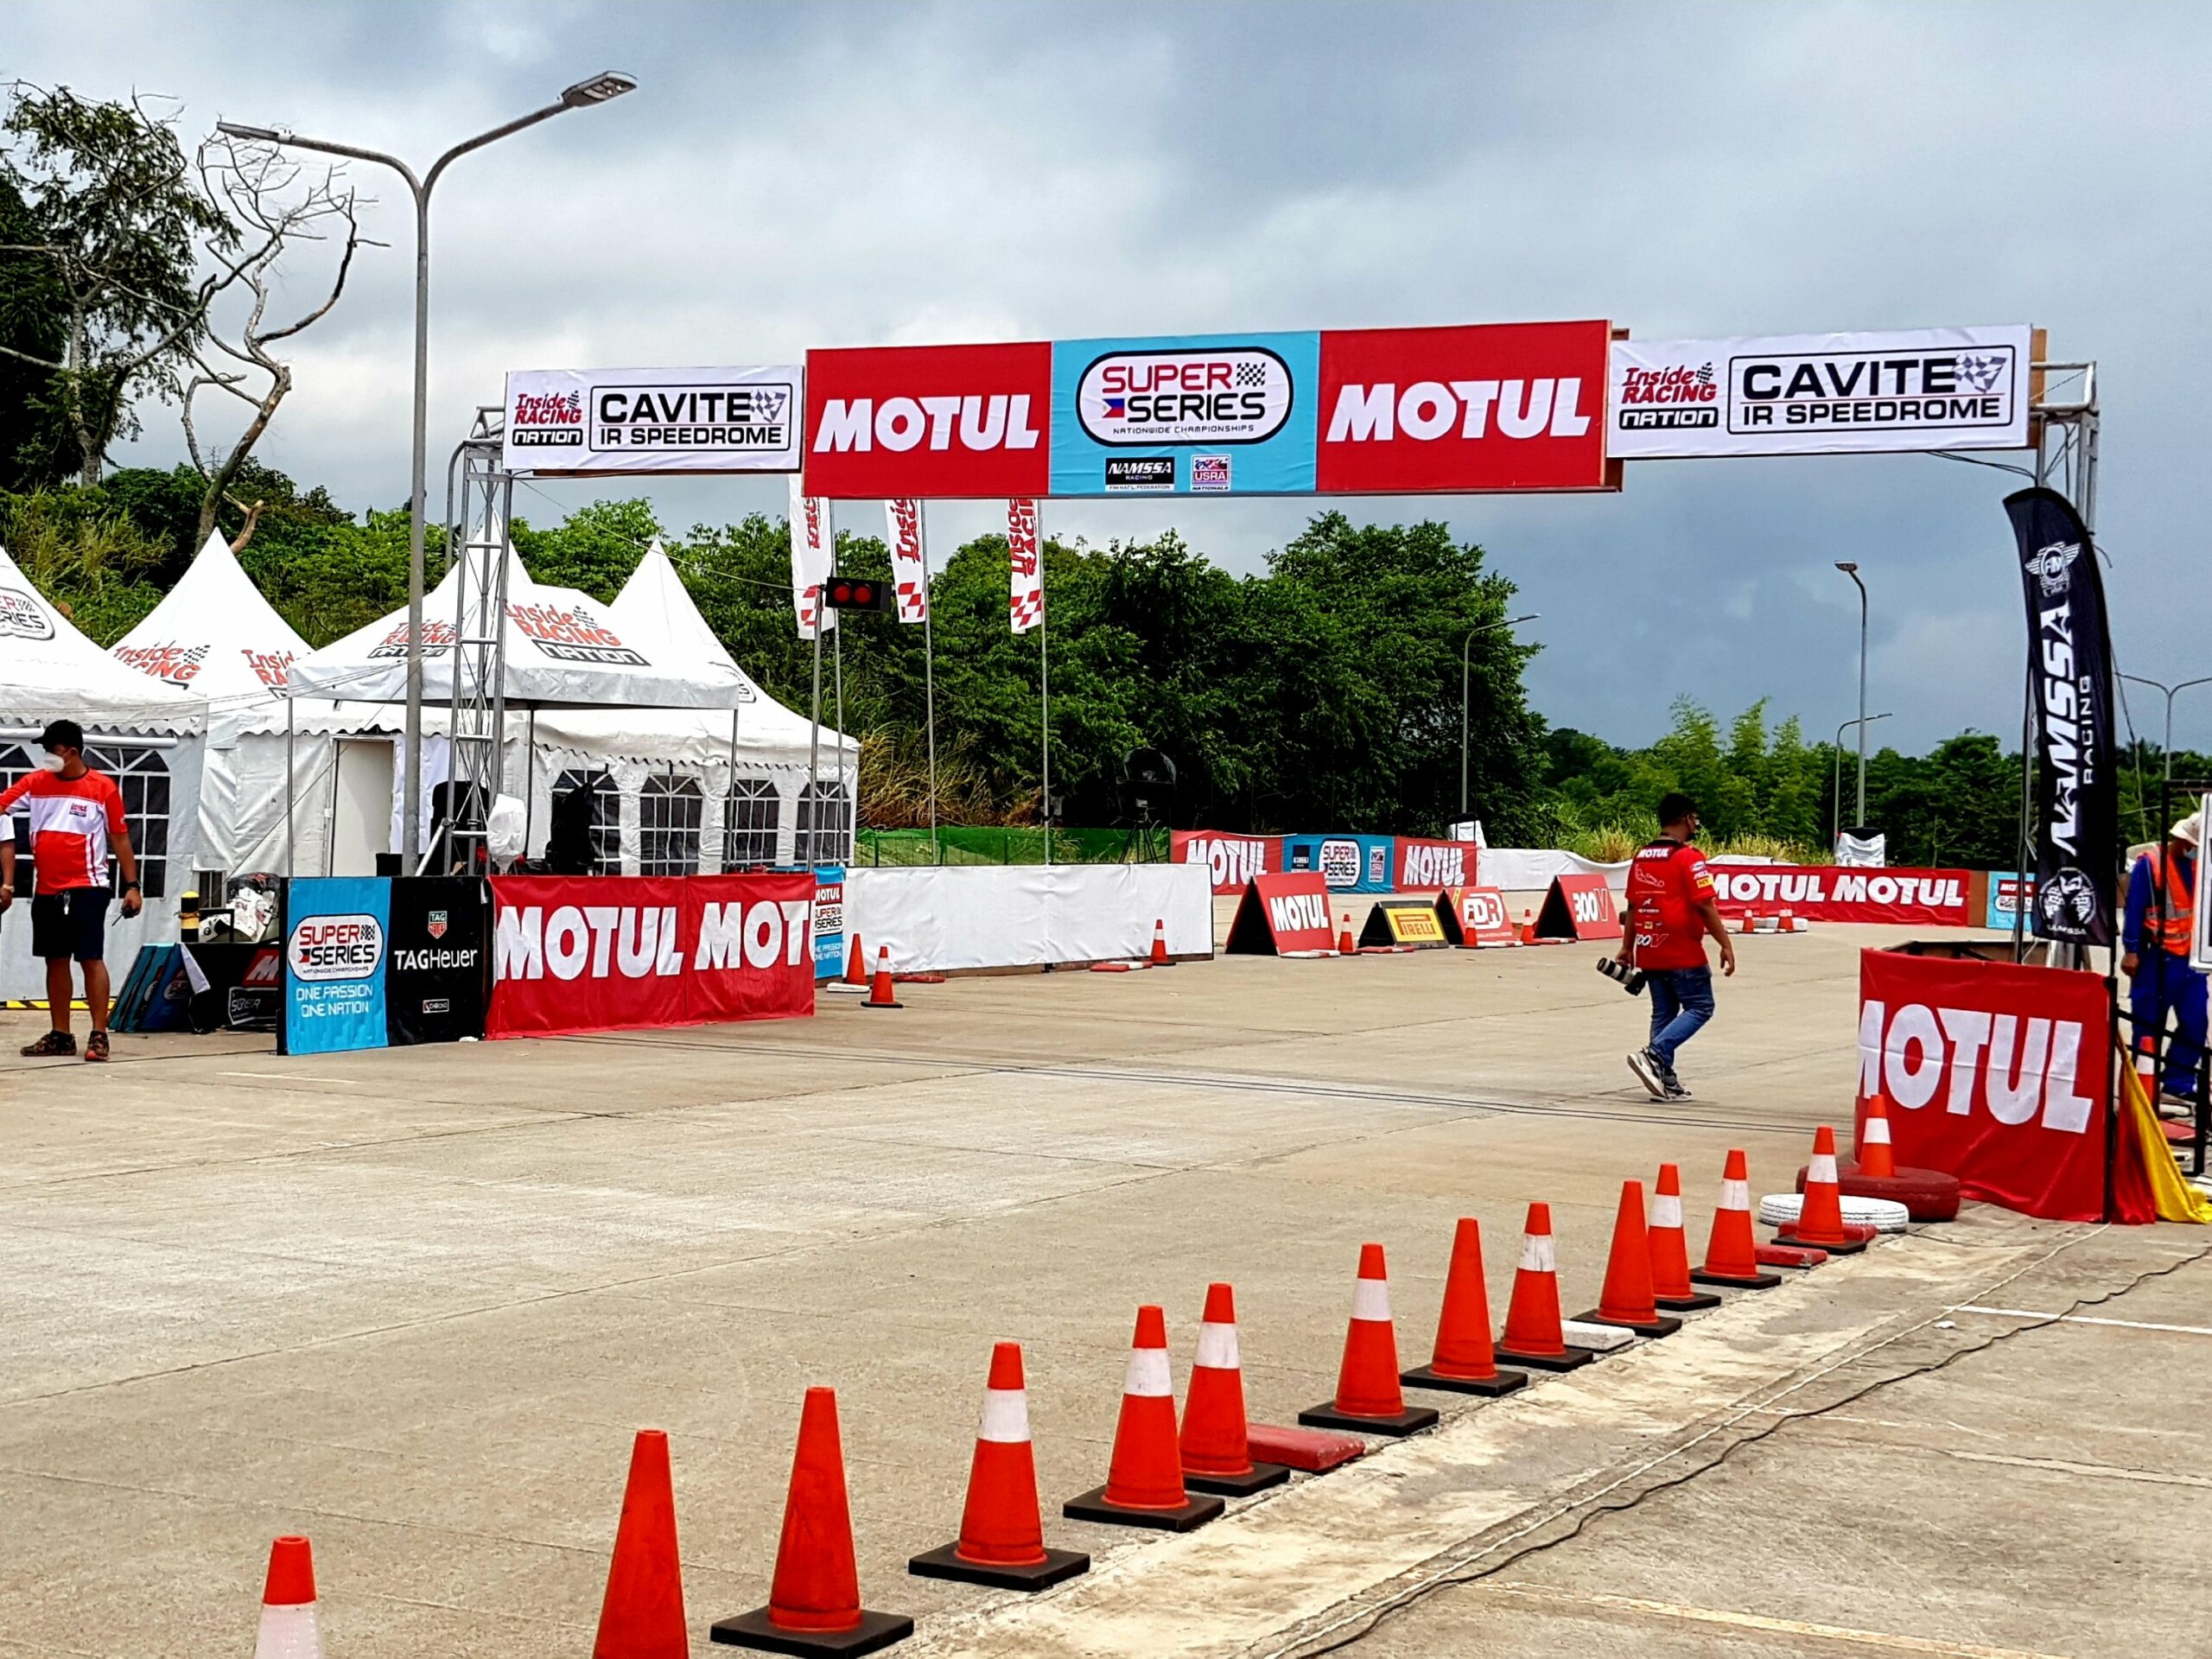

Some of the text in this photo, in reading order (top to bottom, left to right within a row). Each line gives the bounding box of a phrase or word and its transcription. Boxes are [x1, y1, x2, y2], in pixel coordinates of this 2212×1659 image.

[1102, 362, 1233, 394] SUPER
[1622, 364, 1696, 386] Inside
[1743, 357, 1958, 400] CAVITE
[516, 392, 567, 410] Inside
[1622, 383, 1717, 404] RACING
[514, 408, 582, 425] RACING
[600, 392, 752, 423] CAVITE
[1128, 391, 1266, 423] SERIES
[1325, 378, 1591, 442] MOTUL
[1744, 397, 2000, 426] IR SPEEDROME
[812, 394, 1039, 453] MOTUL
[1113, 424, 1255, 435] NATIONWIDE CHAMPIONSHIPS
[601, 427, 782, 445] IR SPEEDROME
[1108, 462, 1172, 474] NAMSSA
[1195, 472, 1226, 480] USRA
[379, 632, 456, 645] RAING
[513, 618, 622, 646] RACING
[2040, 601, 2077, 857] NAMSSA
[2080, 675, 2094, 785] RACING
[1185, 839, 1268, 886] MOTUL
[1323, 846, 1350, 861] SUPER
[1637, 848, 1669, 859] MOTUL
[1328, 861, 1356, 876] SERIES
[1403, 845, 1466, 887] MOTUL
[1831, 875, 1963, 907] MOTUL
[1269, 894, 1329, 932] MOTUL
[1463, 896, 1503, 926] FDR
[1573, 887, 1608, 923] 300V
[431, 913, 446, 922] TAG
[817, 917, 842, 930] SERIES
[1394, 913, 1437, 936] PIRELLI
[299, 924, 360, 945] SUPER
[498, 906, 684, 981] MOTUL
[694, 900, 816, 970] MOT
[1636, 933, 1669, 948] 00V
[310, 944, 375, 966] SERIES
[394, 948, 478, 970] TAGHeuer
[296, 984, 373, 1001] ONE PASSION
[302, 1001, 369, 1017] ONE NATION
